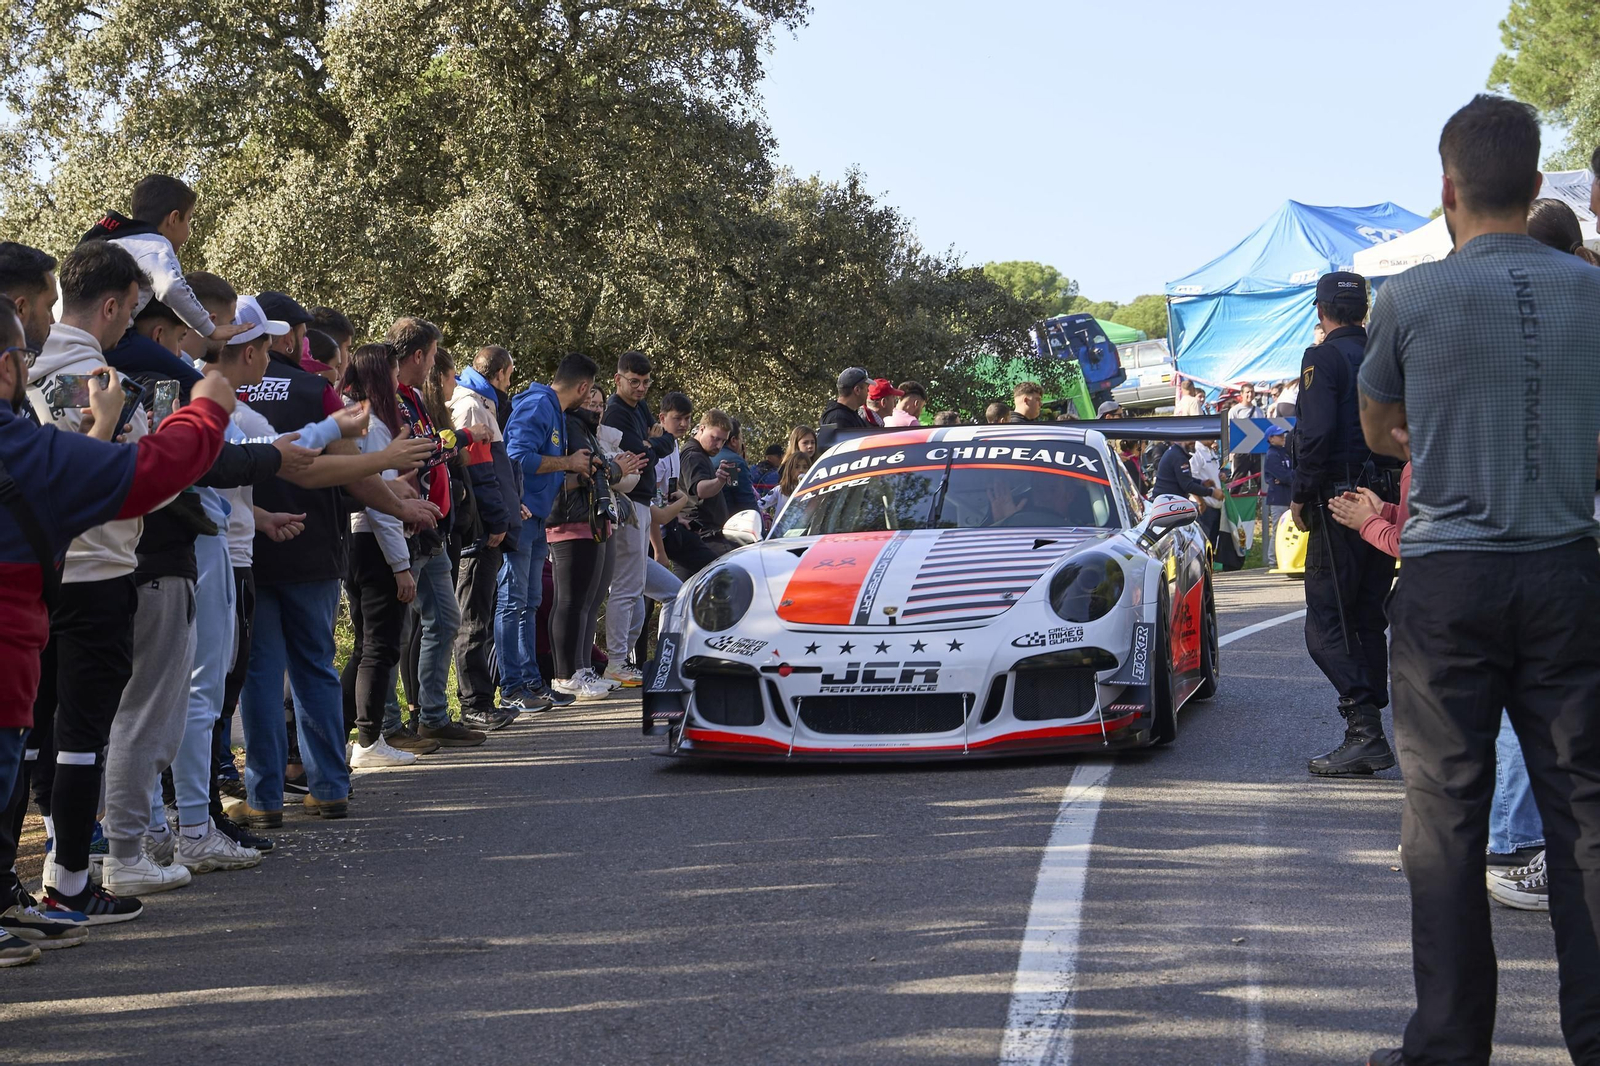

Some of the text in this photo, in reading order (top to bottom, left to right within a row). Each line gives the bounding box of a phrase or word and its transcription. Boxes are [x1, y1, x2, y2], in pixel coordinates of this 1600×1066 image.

[238, 391, 289, 402] MORENA
[808, 446, 1099, 484] André CHIPEAUX
[818, 476, 871, 496] LOPEZ
[1169, 504, 1187, 512] Cup
[1048, 626, 1083, 634] CIRCUITO
[1049, 628, 1084, 641] MIKE G
[1049, 636, 1084, 645] GUADIX
[820, 661, 942, 685] JCR
[819, 684, 938, 693] PERFORMANCE
